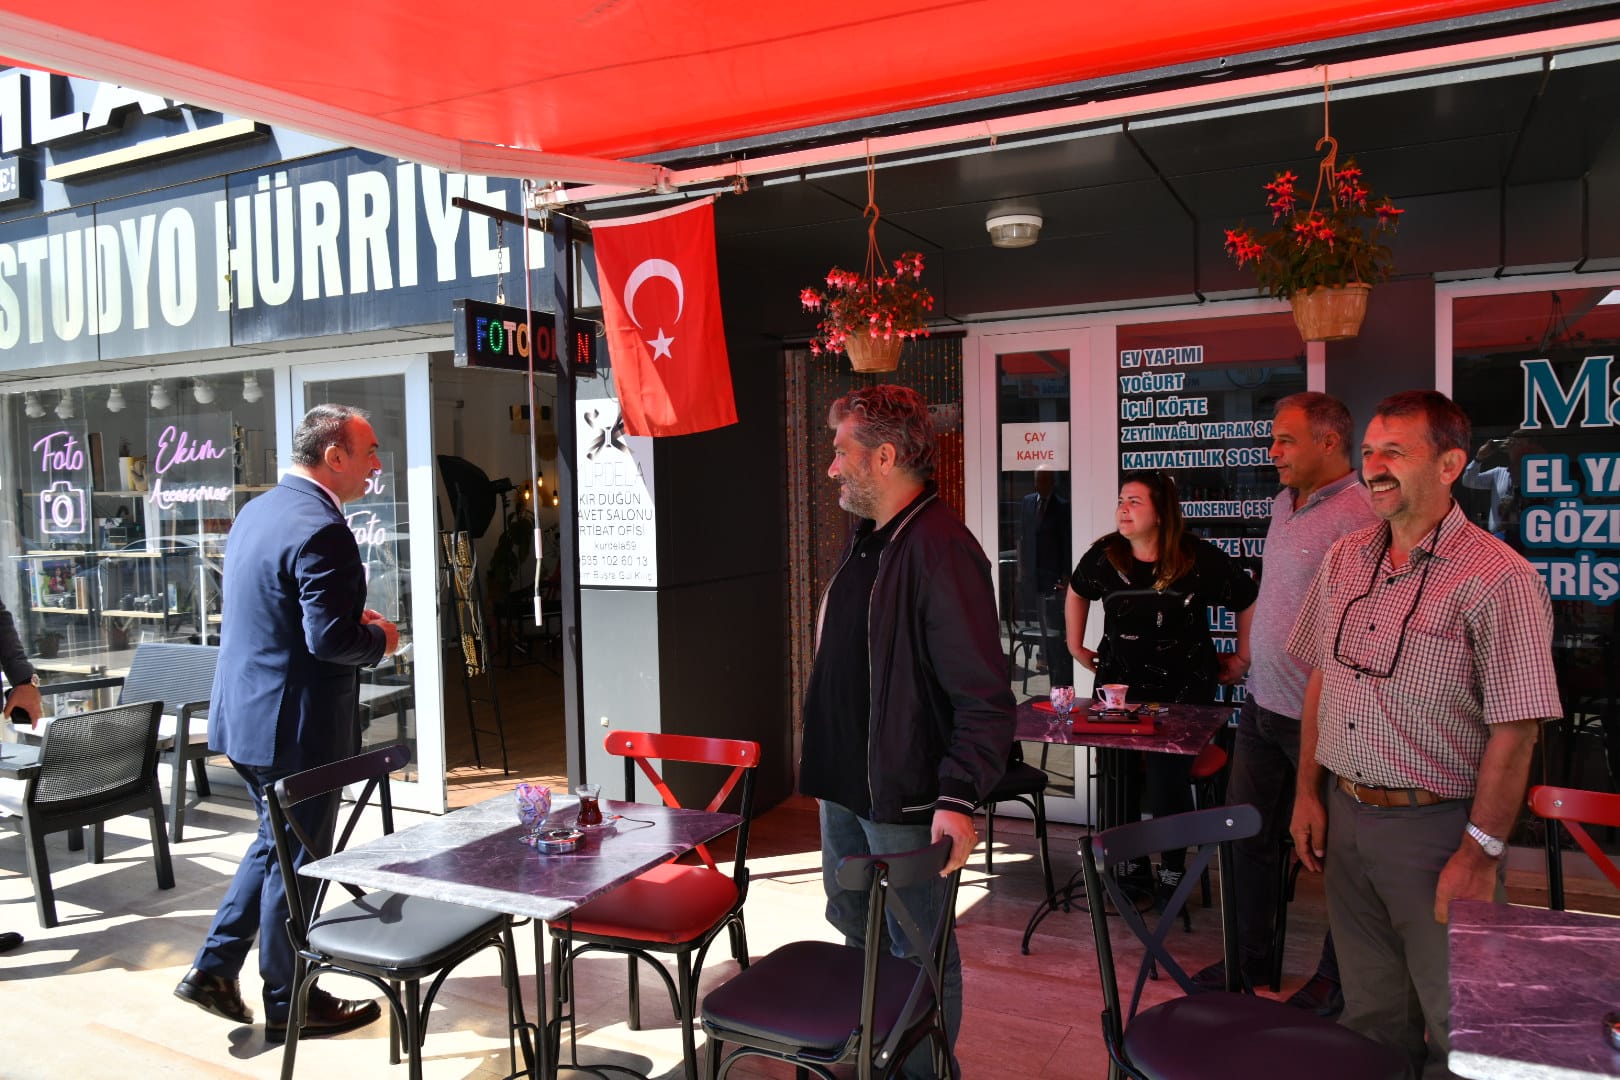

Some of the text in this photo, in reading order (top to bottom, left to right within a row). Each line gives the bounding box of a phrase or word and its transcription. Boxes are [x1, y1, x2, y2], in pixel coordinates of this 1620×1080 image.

[0, 207, 197, 350] STUDYO
[476, 317, 530, 358] FOTO
[1121, 346, 1203, 367] EV YAPIMI
[1120, 372, 1185, 393] YOĞURT
[1122, 397, 1207, 420] İÇLİ KÖFTE
[1024, 432, 1046, 444] ÇAY
[1122, 420, 1273, 443] ZEYTİNYAĞLI YAPRAK SA
[33, 431, 84, 471] Foto
[156, 425, 226, 474] Ekim
[1017, 450, 1054, 460] KAHVE
[1122, 447, 1275, 470] KAHVALTILIK SOSL
[1527, 459, 1573, 492] EL
[598, 491, 641, 505] DÜĞÜN
[1180, 497, 1273, 519] KONSERVE ÇEŞİ
[577, 509, 653, 521] AVET SALONU
[579, 524, 615, 536] RTİBAT
[621, 556, 633, 566] 60
[637, 556, 648, 567] 13
